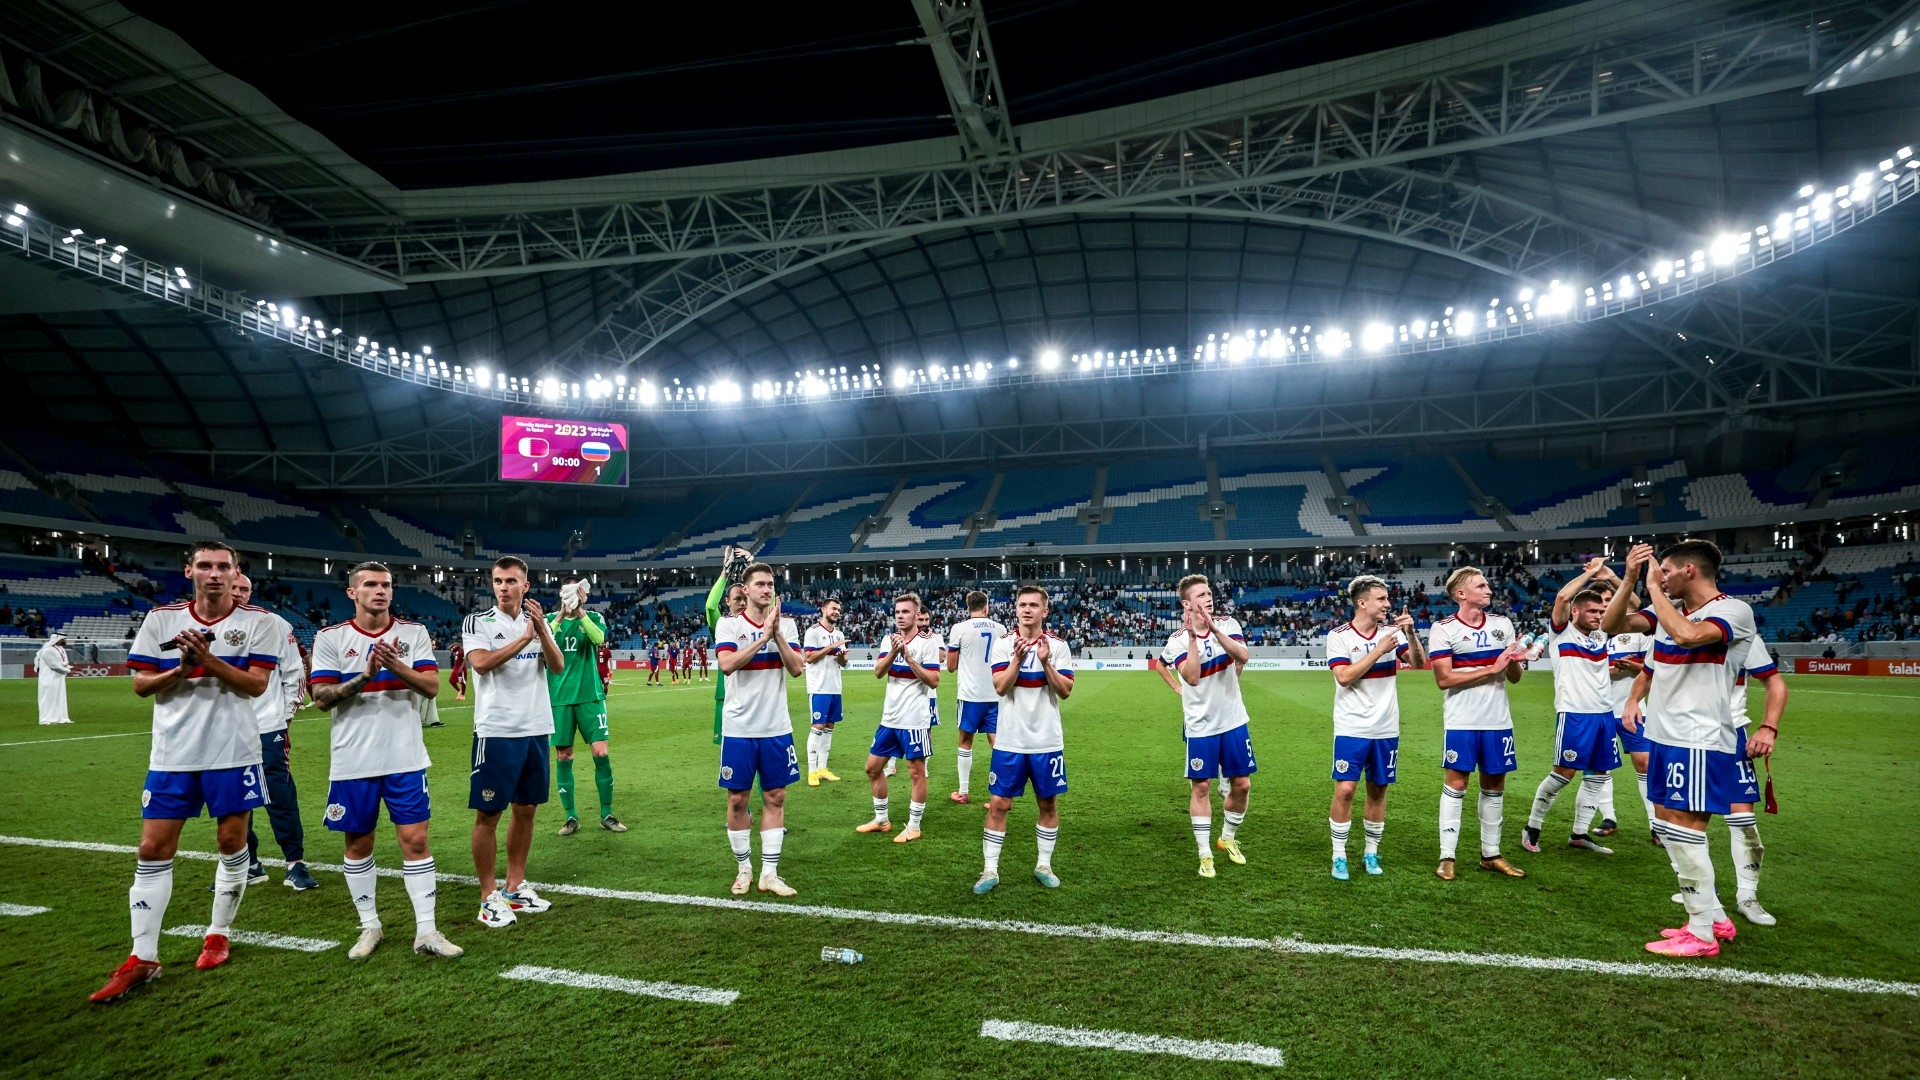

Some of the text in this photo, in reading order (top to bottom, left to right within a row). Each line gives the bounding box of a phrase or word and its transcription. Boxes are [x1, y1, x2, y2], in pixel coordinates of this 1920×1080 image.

[554, 423, 587, 437] 2023
[532, 462, 539, 472] 1
[552, 457, 580, 467] 90:00
[594, 466, 601, 476] 1
[564, 636, 577, 652] 12
[980, 632, 992, 663] 7
[1472, 630, 1491, 648] 22
[1203, 640, 1213, 657] 5
[1818, 663, 1852, 672] МАГНИТ
[597, 713, 608, 729] 12
[907, 729, 922, 746] 10
[1502, 735, 1515, 756] 22
[786, 745, 797, 768] 19
[1050, 755, 1064, 777] 27
[1736, 760, 1756, 784] 15
[243, 765, 256, 787] 3
[1665, 762, 1685, 788] 26
